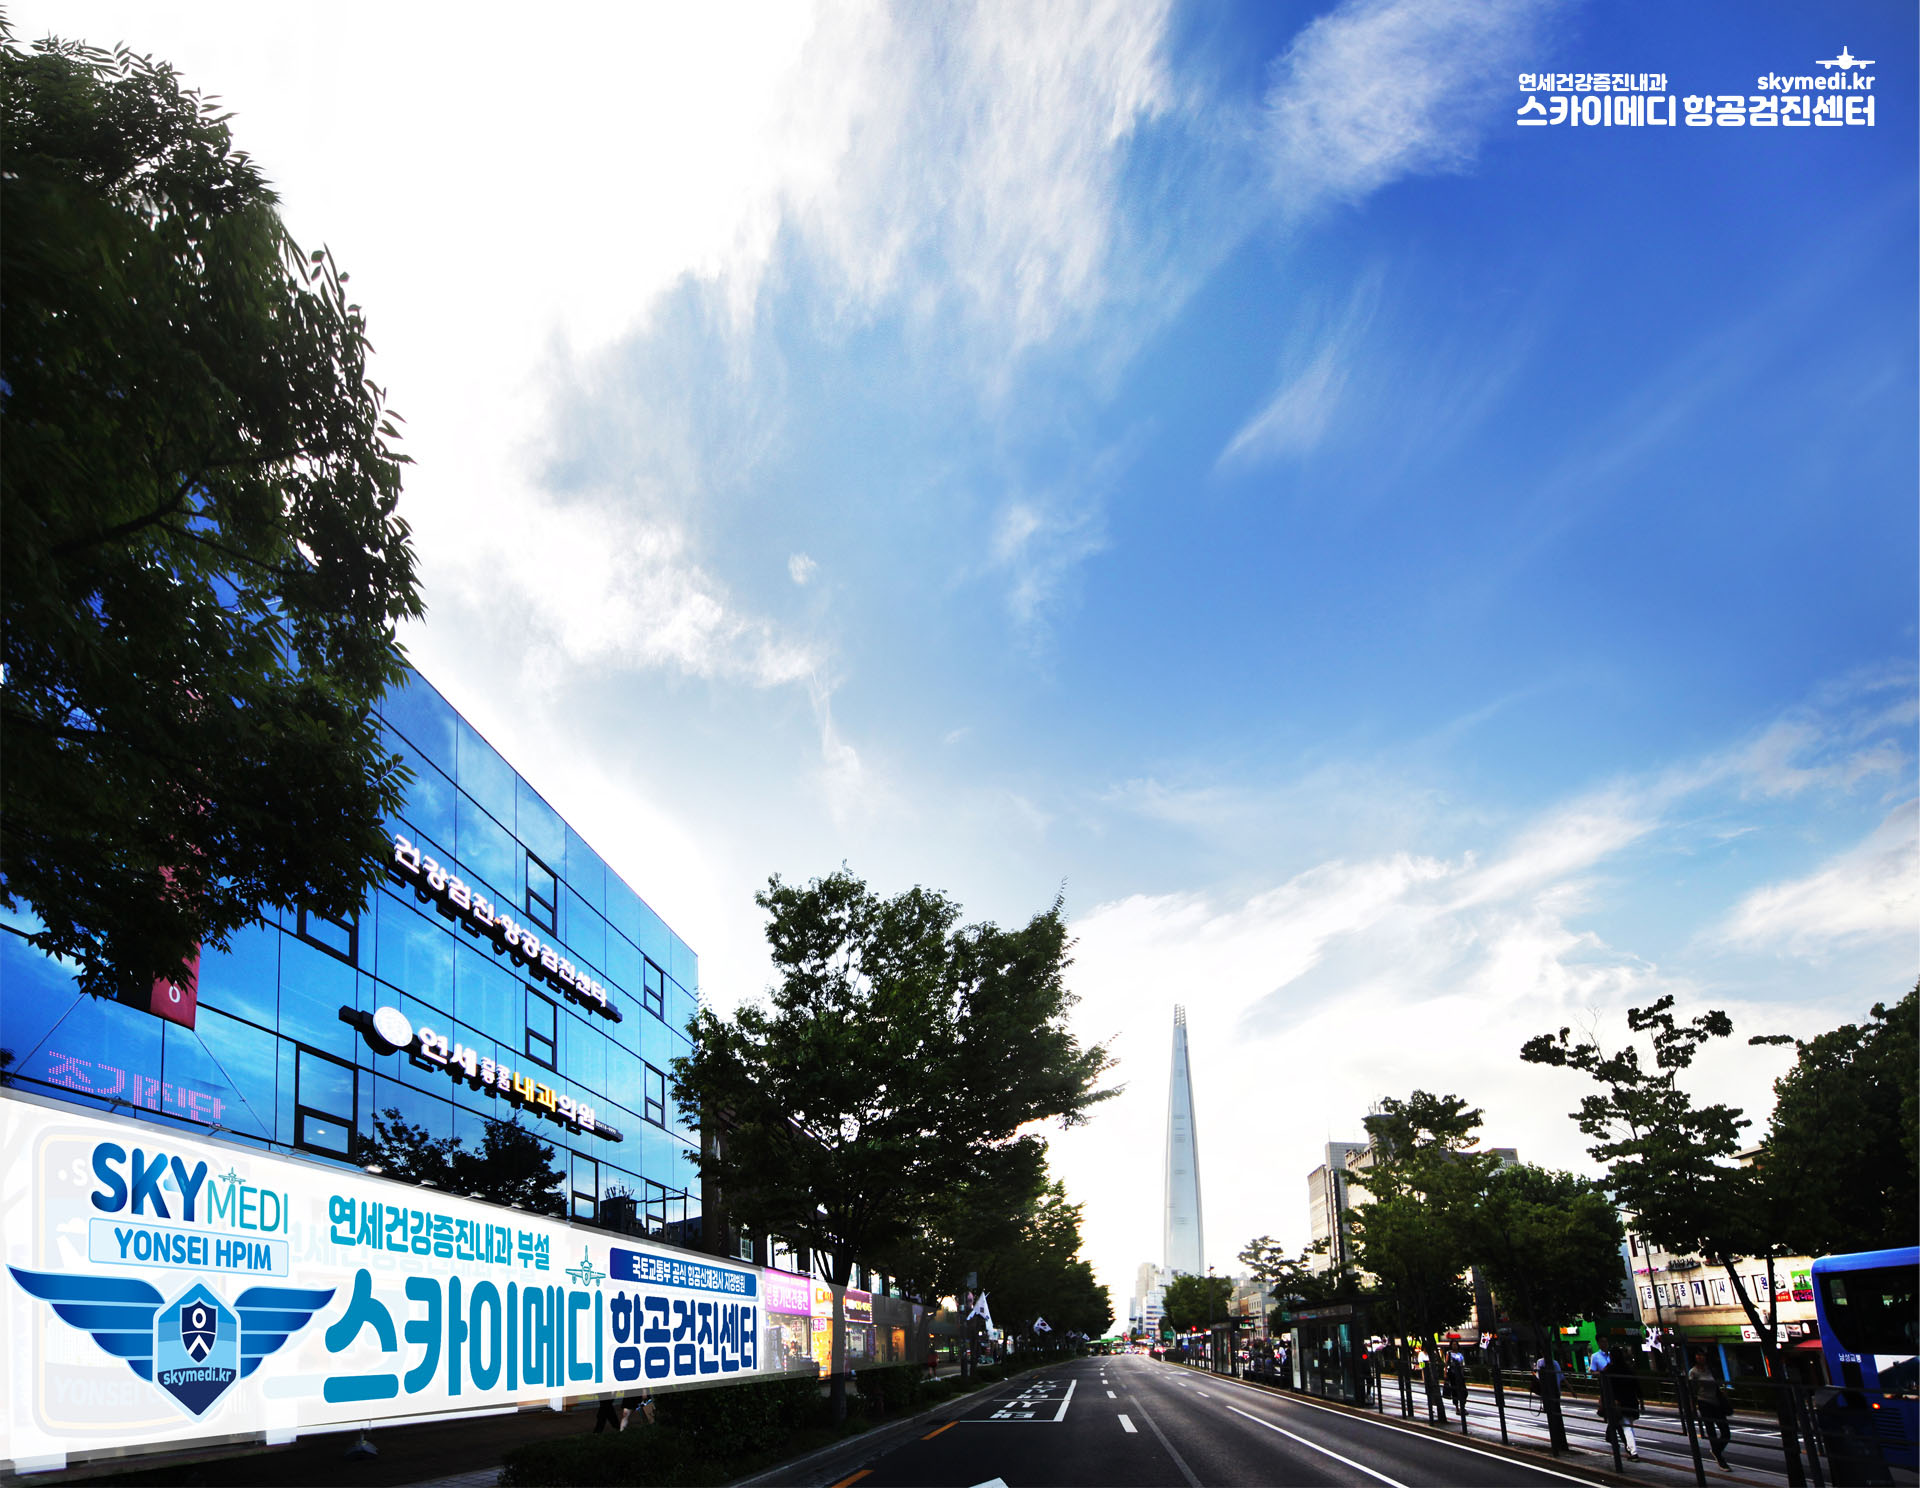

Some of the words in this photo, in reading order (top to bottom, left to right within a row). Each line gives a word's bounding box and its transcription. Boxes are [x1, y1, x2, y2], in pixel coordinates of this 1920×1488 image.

[114, 1227, 209, 1266] YONSEI
[215, 1239, 272, 1271] HPIM
[328, 1194, 514, 1267] 연세건강증진내과
[517, 1227, 550, 1271] 부설
[632, 1255, 671, 1283] 국토교통부
[672, 1262, 687, 1286] 공식
[687, 1264, 724, 1290] 항공신체검사
[724, 1271, 746, 1293] 지정병원
[323, 1267, 604, 1403] 스카이메디
[611, 1290, 758, 1382] 항공검진센터
[163, 1365, 232, 1386] skymedi.kr
